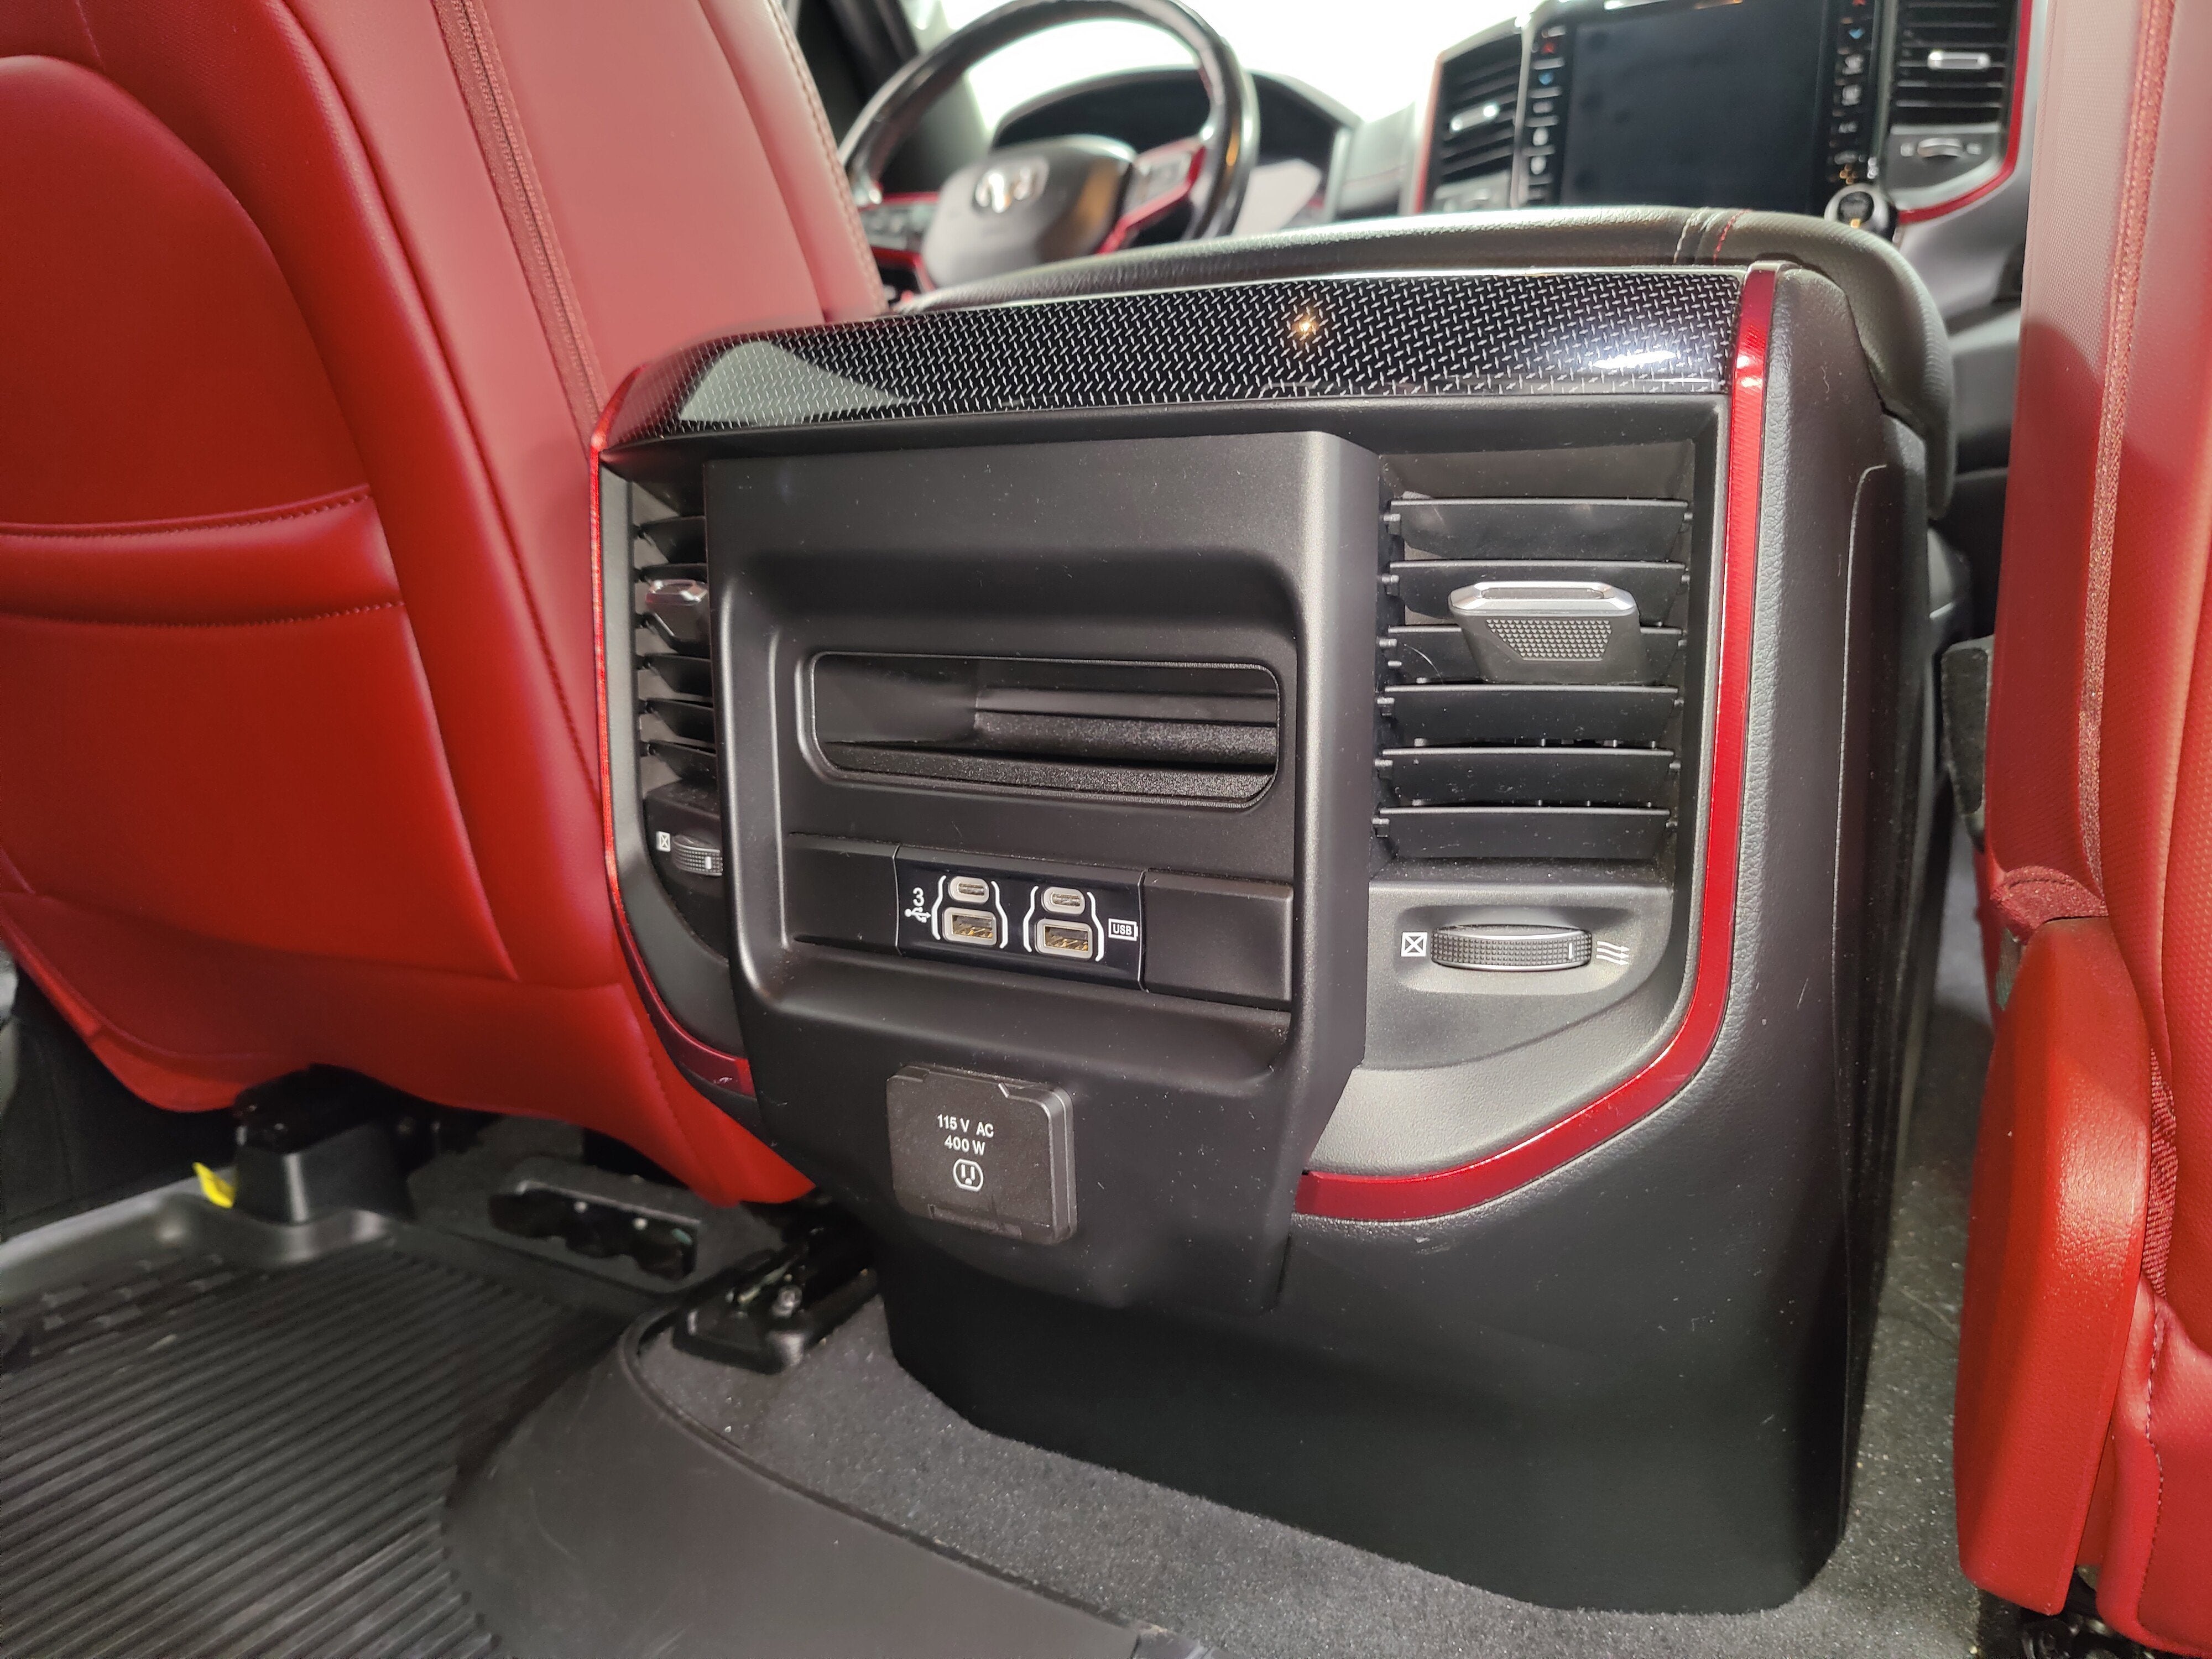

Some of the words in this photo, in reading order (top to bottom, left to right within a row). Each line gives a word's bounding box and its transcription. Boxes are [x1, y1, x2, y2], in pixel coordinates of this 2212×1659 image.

[912, 887, 925, 907] 3
[1113, 923, 1132, 936] USB
[937, 1114, 957, 1131] 115
[960, 1118, 970, 1133] V
[975, 1121, 994, 1139] AC
[944, 1135, 969, 1153] 400
[972, 1140, 985, 1156] W
